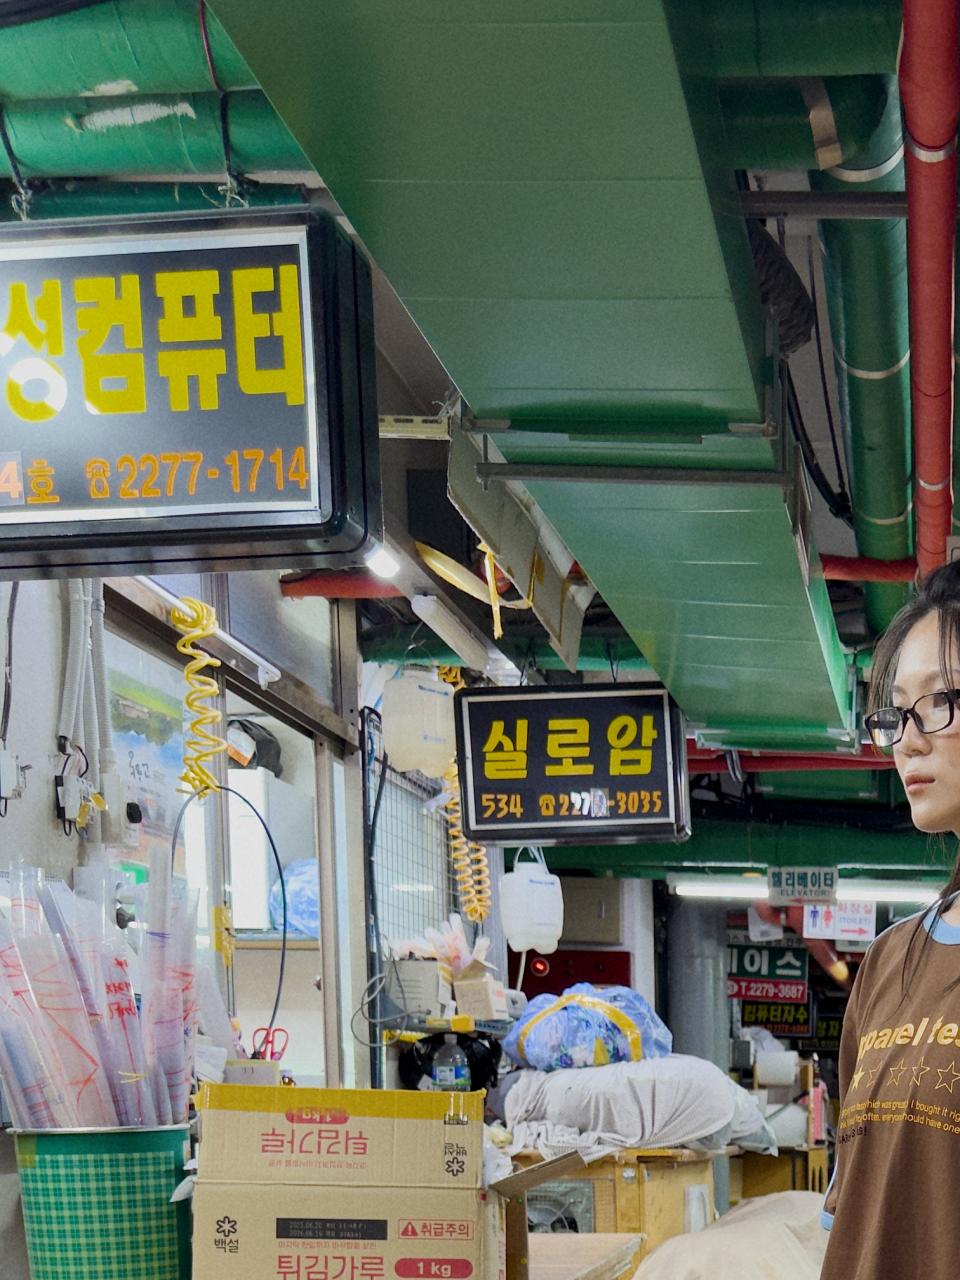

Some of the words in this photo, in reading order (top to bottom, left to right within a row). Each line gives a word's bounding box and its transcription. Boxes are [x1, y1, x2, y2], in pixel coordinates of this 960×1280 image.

[117, 447, 309, 498] 2277-1714
[482, 714, 658, 780] 실로암
[481, 793, 523, 819] 534
[916, 1101, 941, 1115] bought
[941, 1106, 948, 1116] it
[420, 1222, 470, 1238] 취급주의
[214, 1238, 239, 1254] 백설
[430, 1261, 451, 1278] kg
